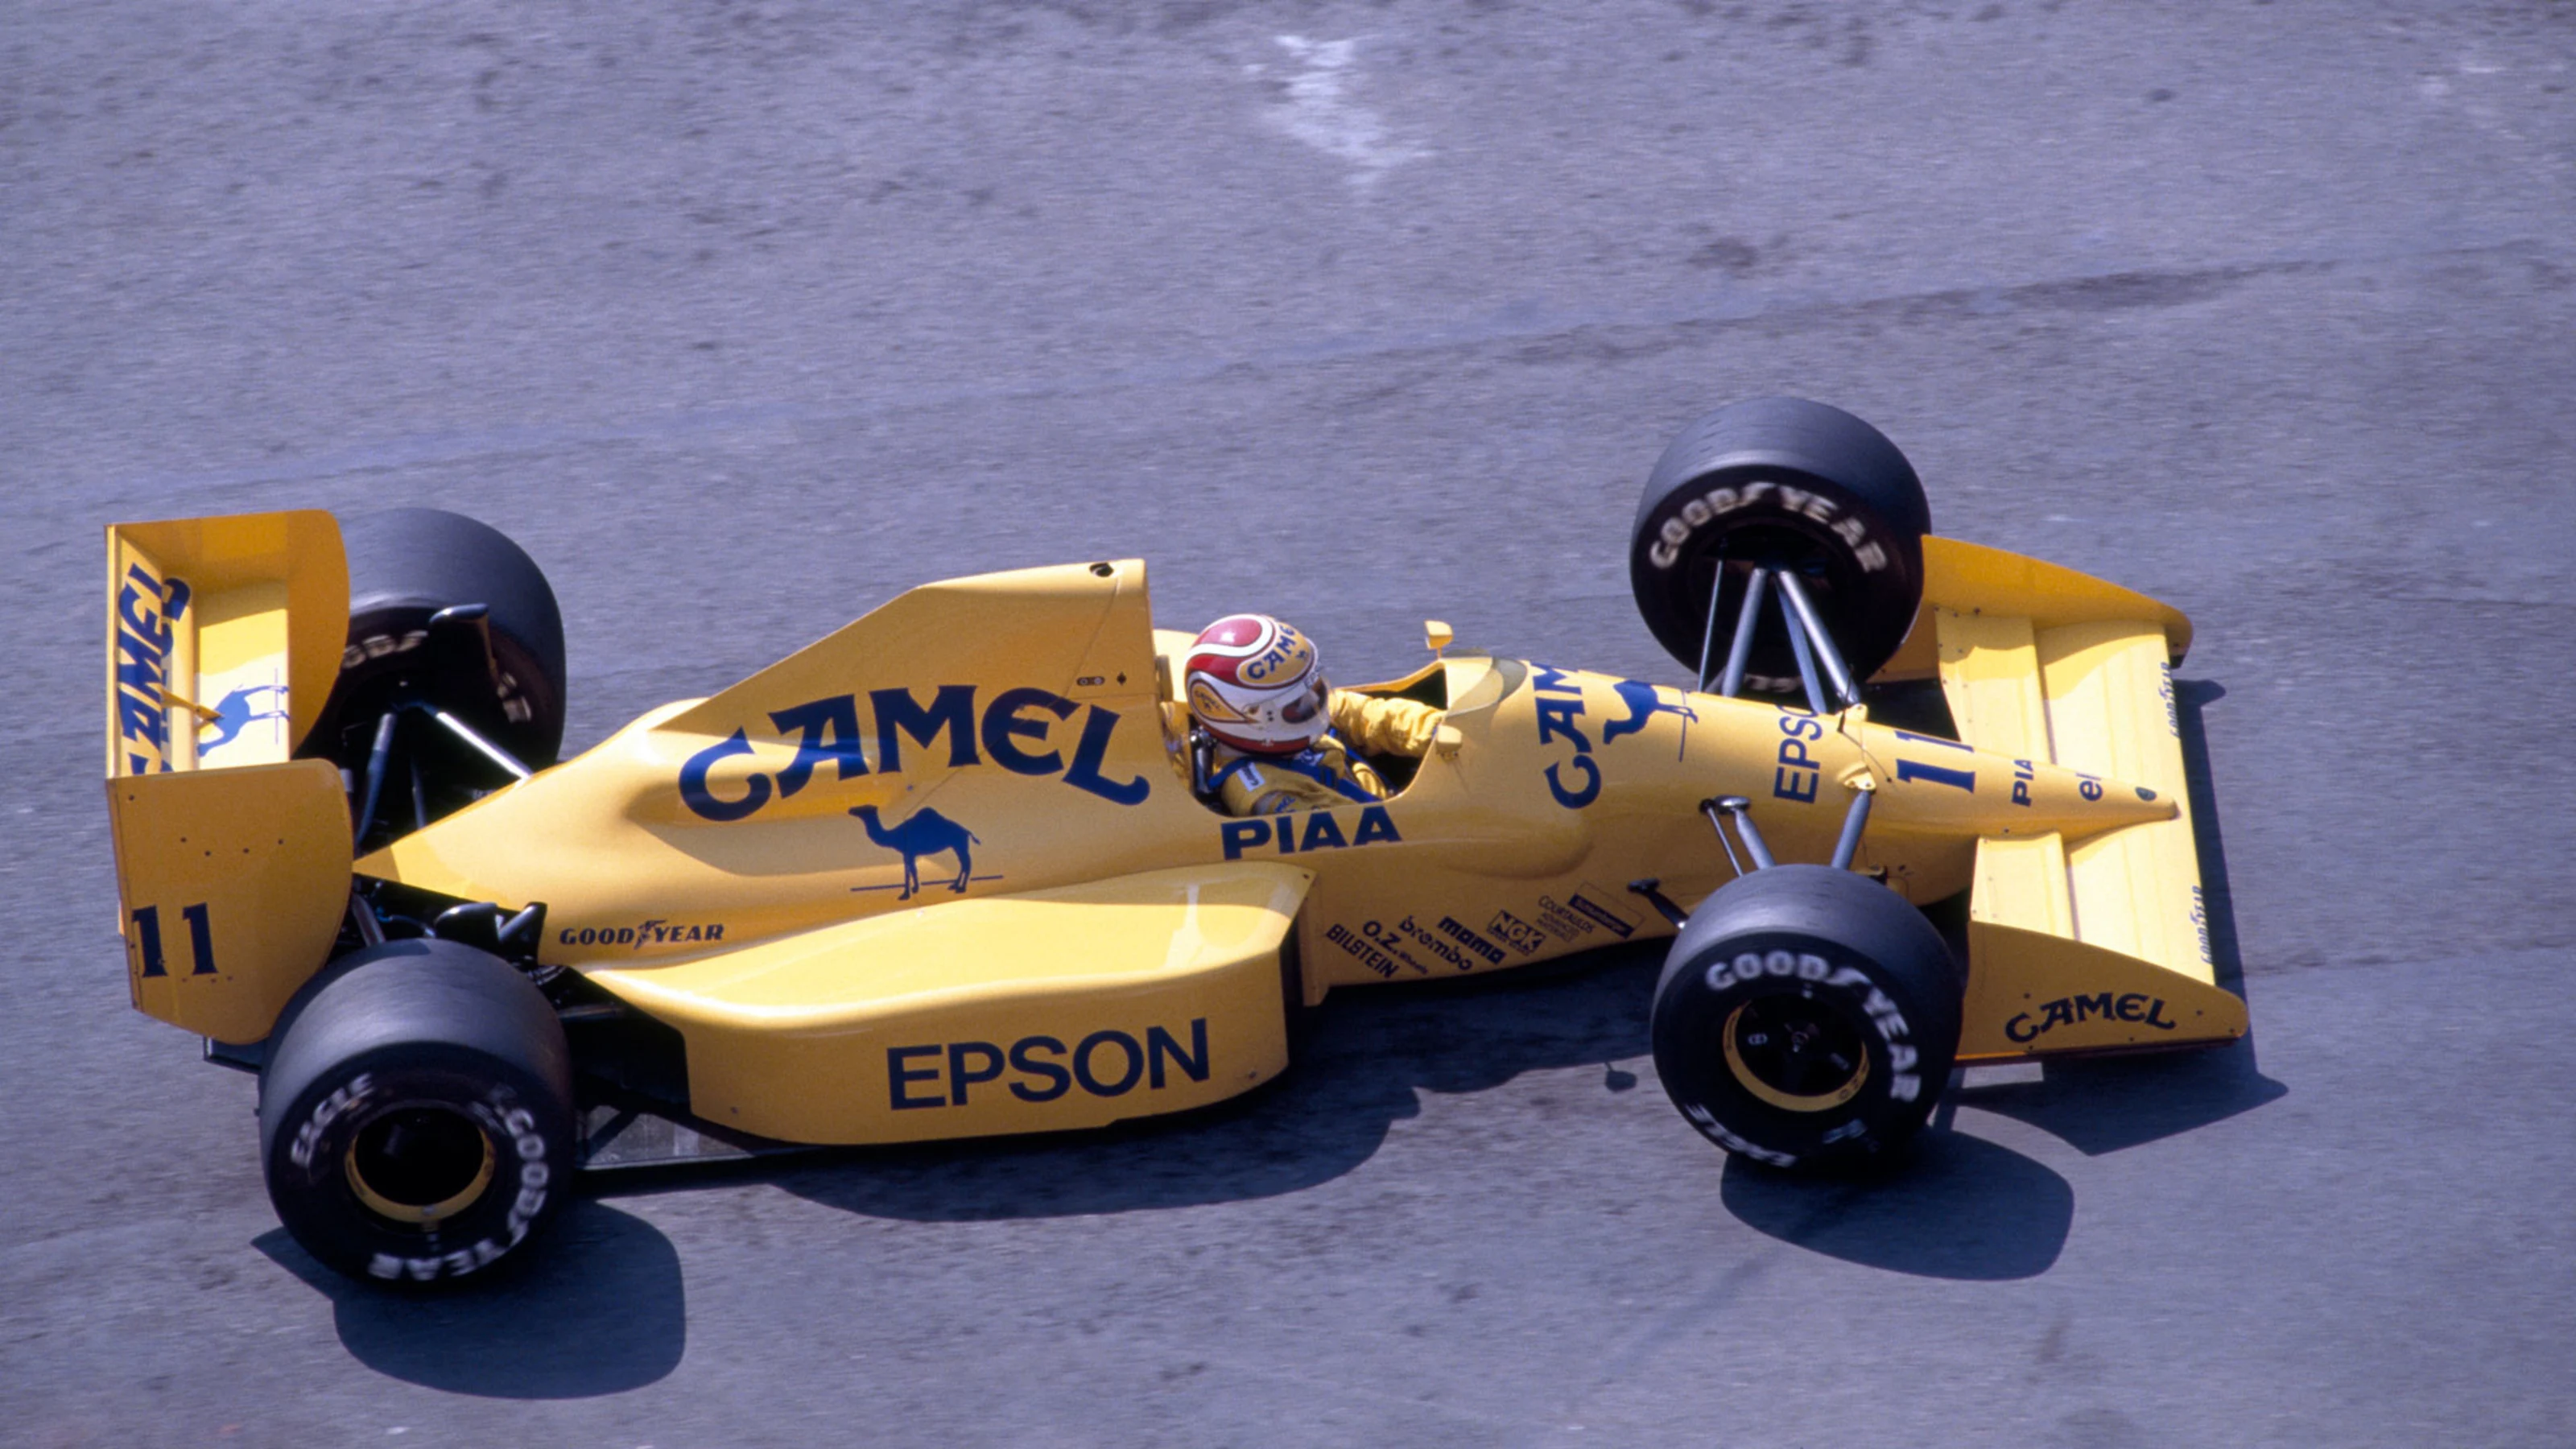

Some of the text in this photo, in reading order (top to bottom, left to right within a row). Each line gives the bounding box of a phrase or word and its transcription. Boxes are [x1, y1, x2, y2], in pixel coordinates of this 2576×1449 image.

[679, 685, 1150, 822] CAMEL
[1220, 806, 1402, 861] PIAA
[132, 902, 218, 977] 11
[559, 919, 724, 950] GOODYEAR
[1326, 923, 1400, 978] BILSTEIN
[1398, 915, 1473, 971] brembo
[1437, 916, 1507, 965] momo
[1491, 910, 1546, 953] NGK
[1705, 950, 1922, 1103] GOODYEAR
[2004, 992, 2177, 1042] CAMEL
[887, 1018, 1209, 1110] EPSON
